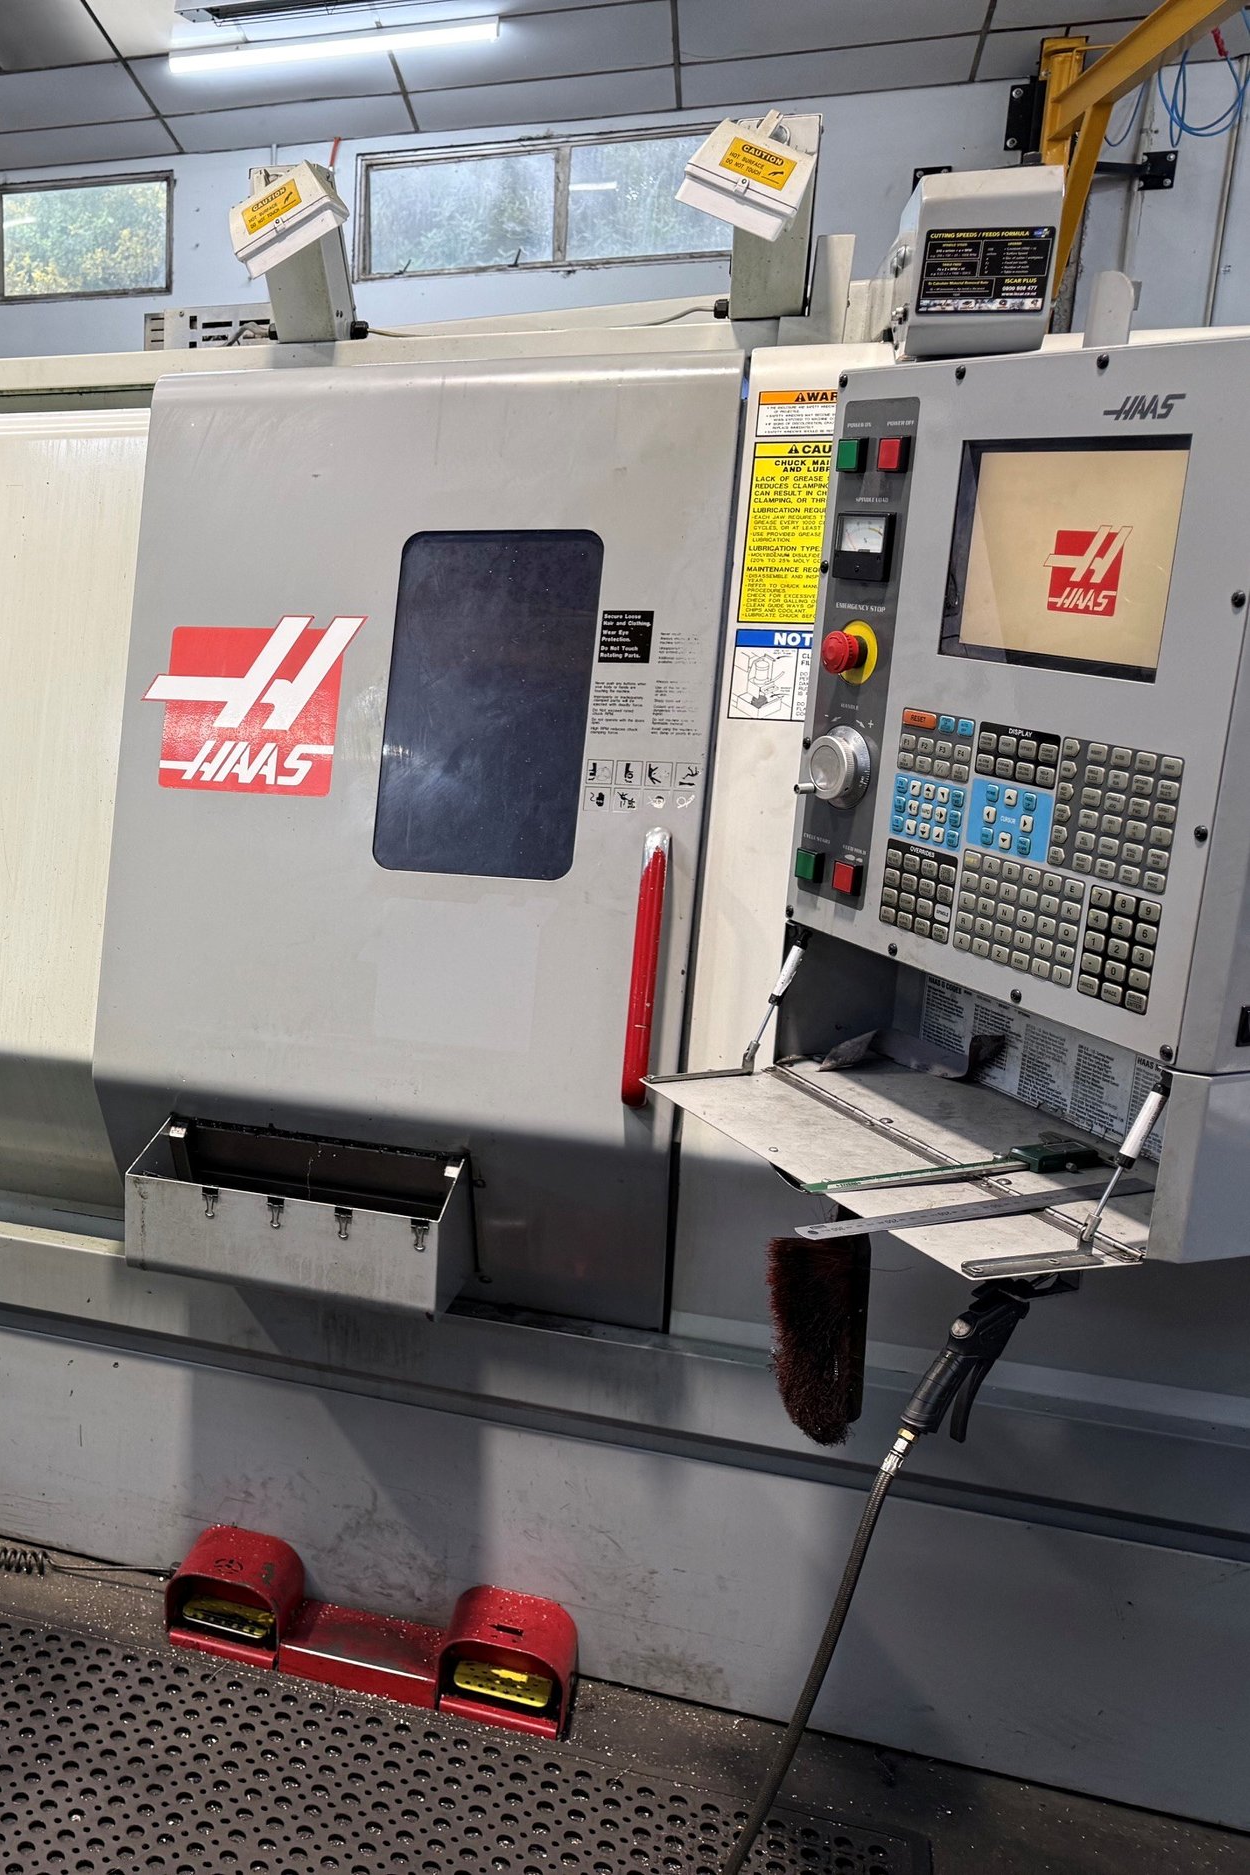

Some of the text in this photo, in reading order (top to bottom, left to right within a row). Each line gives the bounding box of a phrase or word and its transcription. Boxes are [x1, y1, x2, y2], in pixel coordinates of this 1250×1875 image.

[744, 145, 784, 165] CAUTION
[742, 157, 764, 169] SURFACE
[746, 166, 761, 176] TOUCH
[252, 187, 286, 211] CAUTION
[259, 203, 278, 216] SURFACE
[267, 208, 279, 218] TOUCH
[1103, 393, 1186, 421] HAAS
[1048, 587, 1117, 611] HAAS
[836, 602, 886, 612] EMERGENCY STOP
[1009, 728, 1032, 737] DISPLAY
[159, 739, 334, 786] HAAS
[910, 846, 935, 858] OVERRIDES
[1098, 892, 1103, 900] 7
[1121, 900, 1126, 908] 8
[1067, 907, 1072, 915] K
[1146, 907, 1151, 915] 9
[1118, 923, 1123, 931] 5
[1143, 930, 1148, 938] 6
[1092, 938, 1095, 946] 1
[1114, 945, 1120, 954] 2
[1139, 953, 1144, 961] 3
[1111, 967, 1116, 975] 0
[1104, 988, 1117, 997] SPACE
[1137, 1057, 1153, 1069] HAAS
